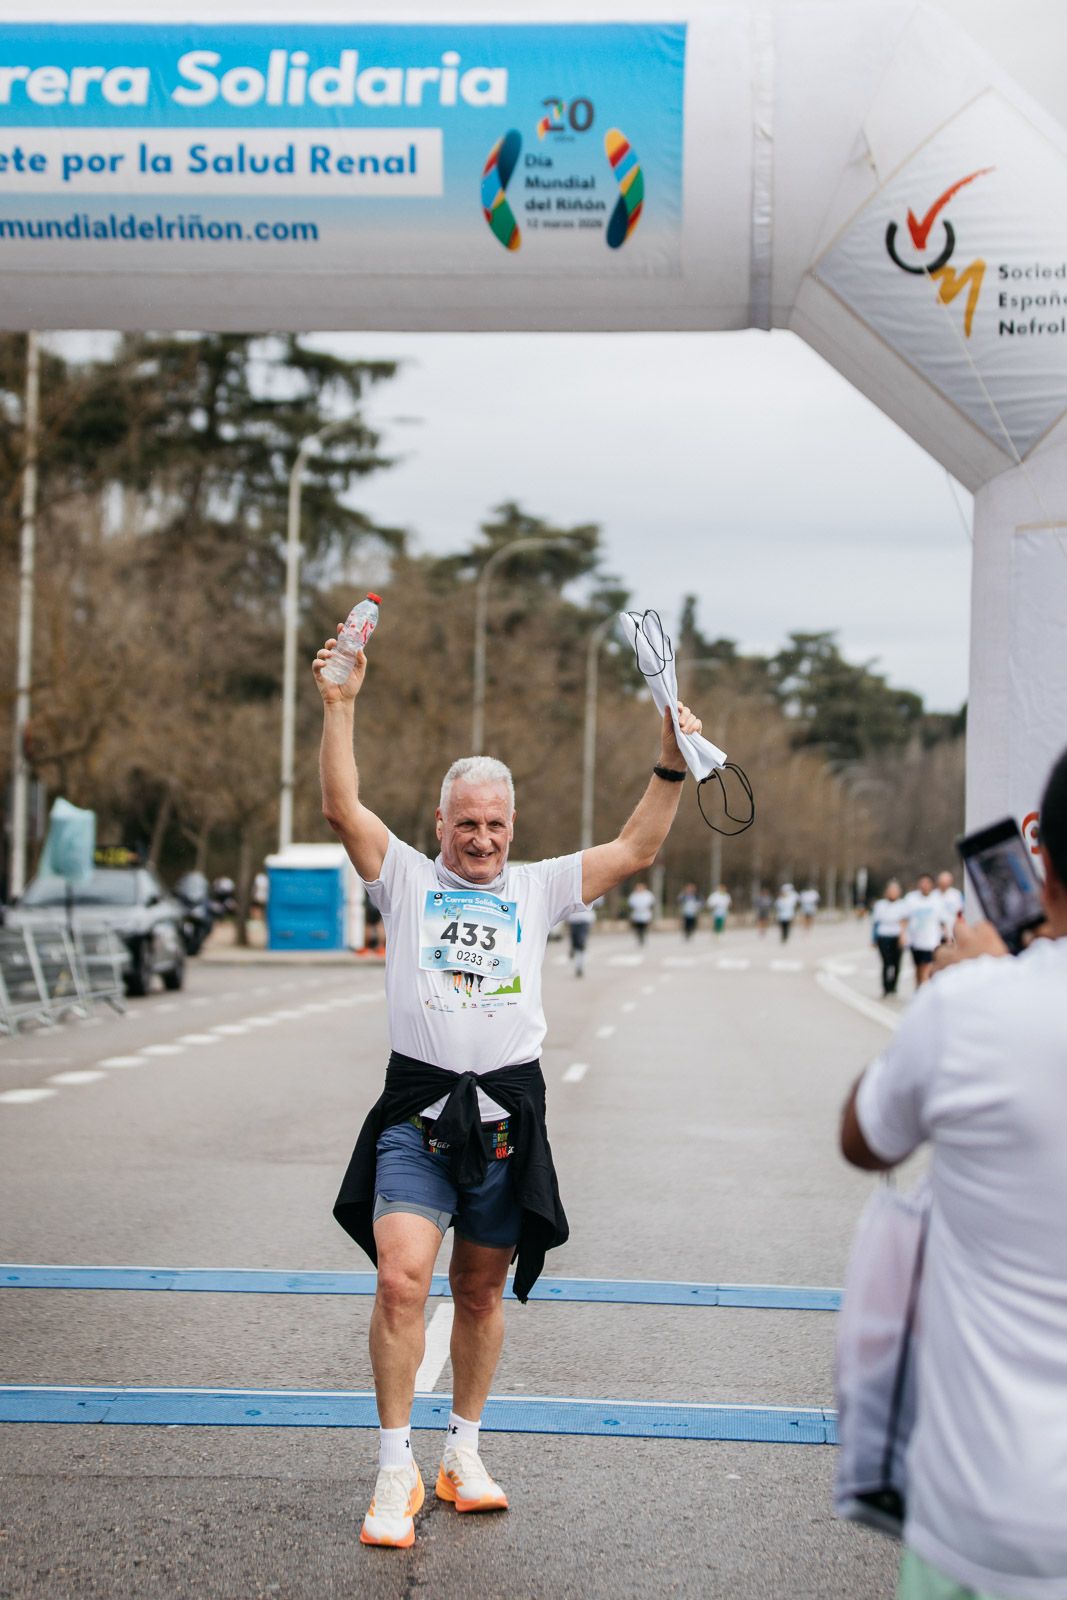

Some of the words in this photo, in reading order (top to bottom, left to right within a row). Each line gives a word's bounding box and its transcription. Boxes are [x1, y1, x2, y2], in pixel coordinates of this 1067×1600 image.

[171, 49, 508, 107] Solidaria
[539, 97, 595, 133] 20
[62, 153, 124, 182] por
[140, 143, 172, 173] la
[188, 143, 296, 174] Salud
[310, 143, 417, 174] Renal
[525, 175, 595, 189] Mundial
[525, 197, 551, 211] del
[0, 213, 319, 242] mundialdelriñon.com
[440, 921, 498, 951] 433
[456, 950, 483, 966] 0233
